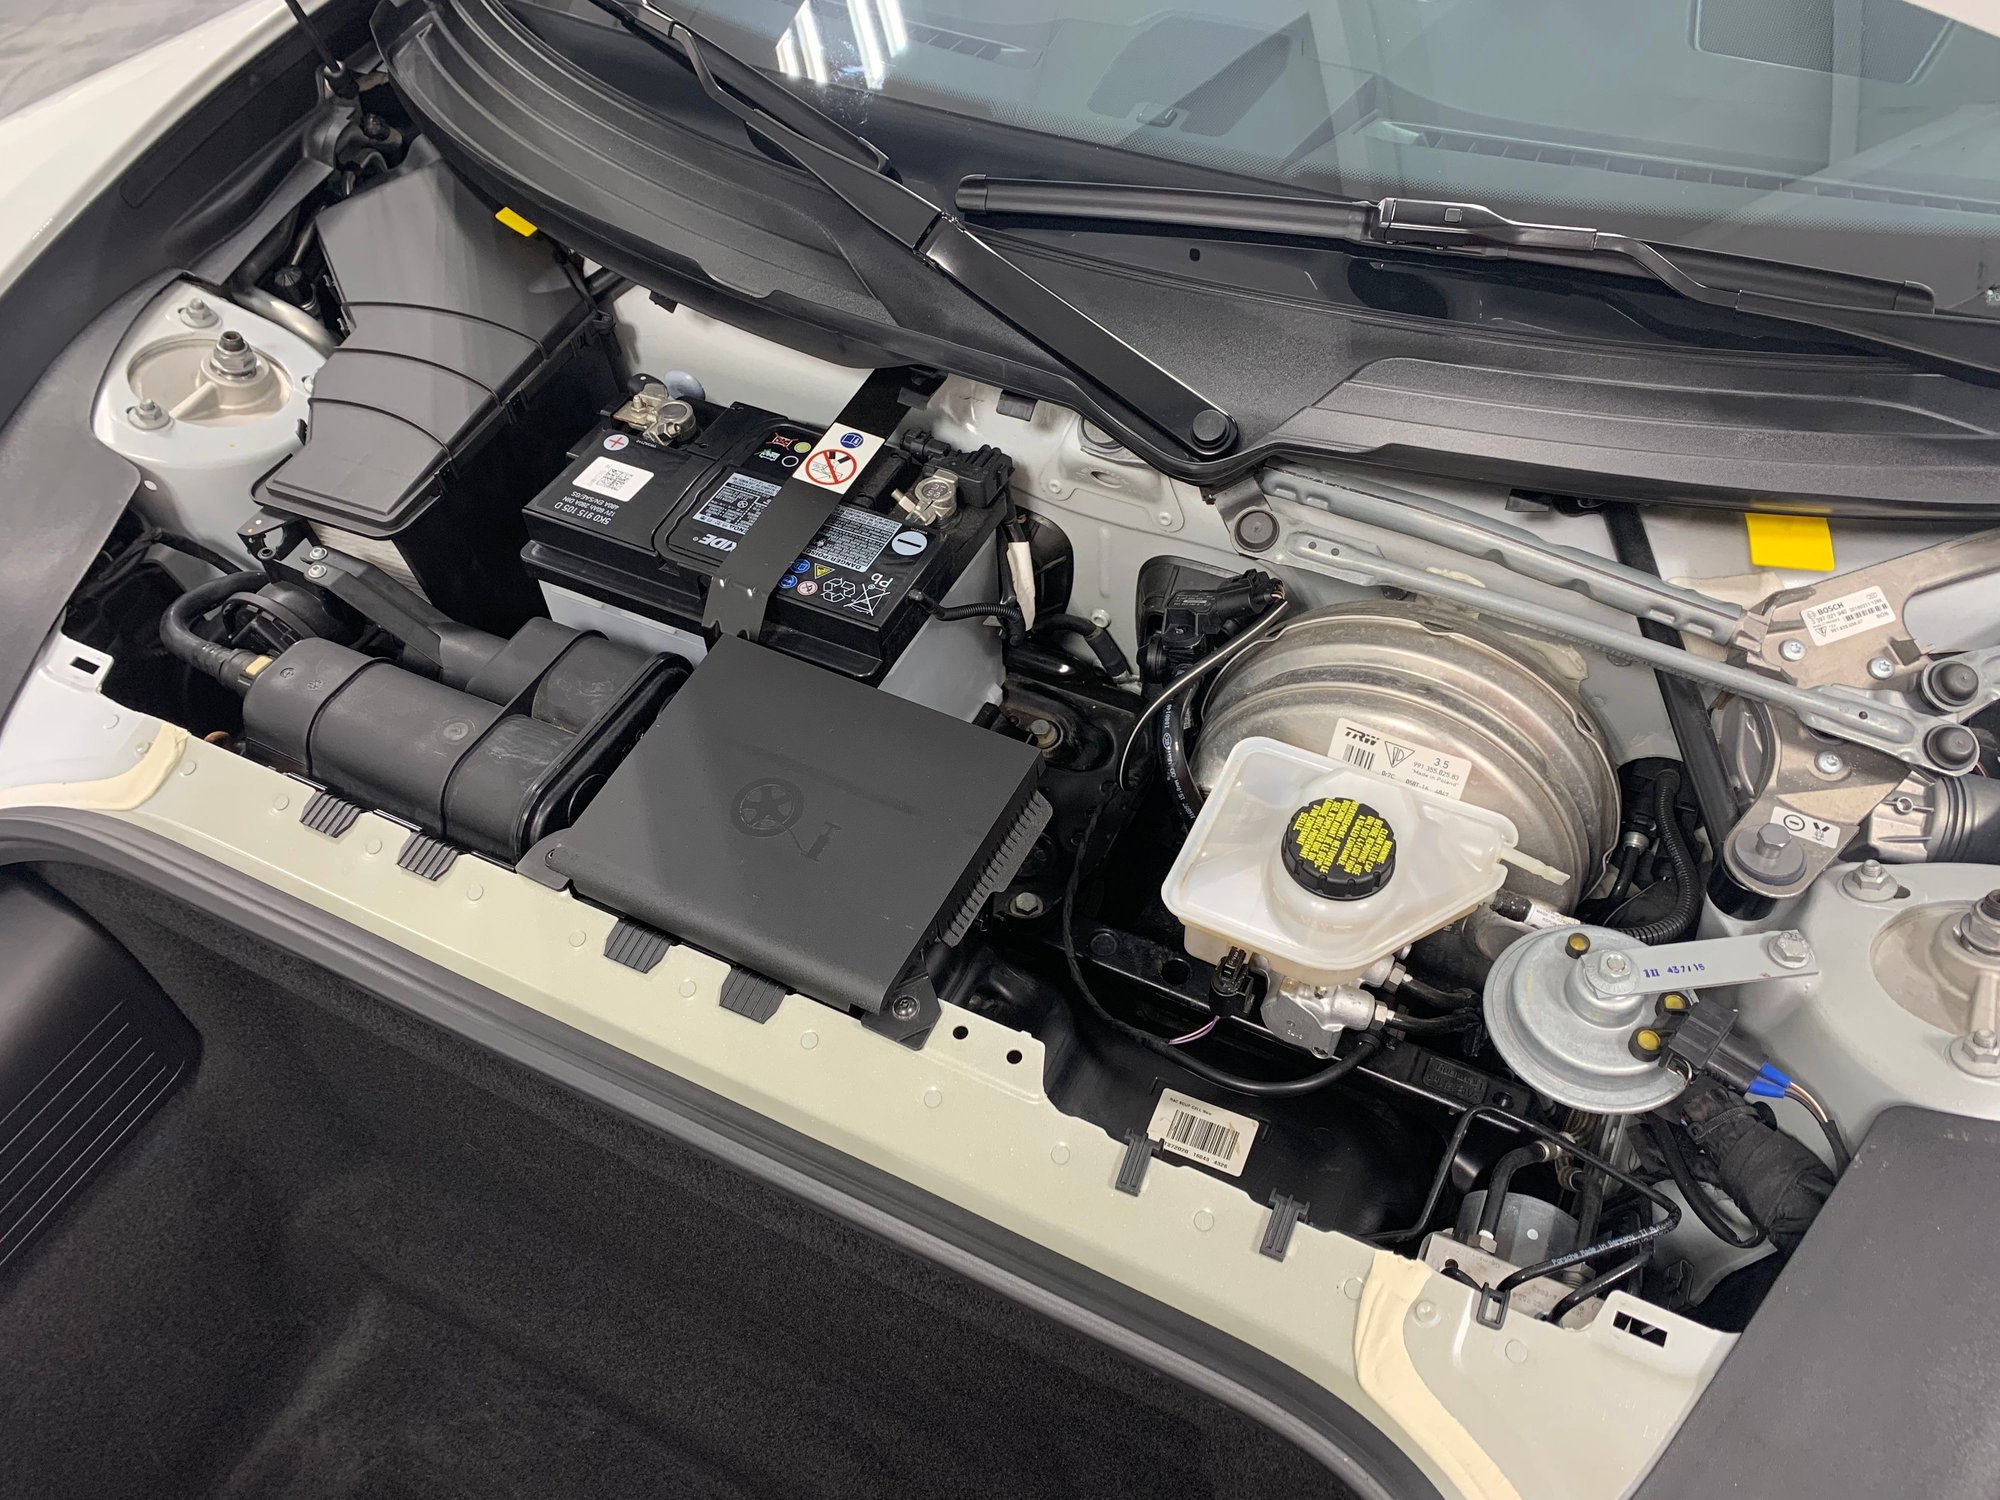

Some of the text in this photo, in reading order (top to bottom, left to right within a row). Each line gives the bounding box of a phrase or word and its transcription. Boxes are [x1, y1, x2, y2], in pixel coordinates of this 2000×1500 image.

[562, 496, 575, 504] DIN
[554, 501, 611, 525] 5K0 915 105 D
[698, 534, 737, 551] XIDE
[871, 573, 893, 587] Pb
[1817, 602, 1844, 615] BOSCH
[1345, 727, 1379, 745] TRW
[1434, 757, 1449, 769] 3.5
[1296, 815, 1315, 845] CONTENANT
[1328, 821, 1340, 837] AVANT
[1350, 819, 1364, 838] SEALED
[1362, 816, 1375, 829] ONLY
[1323, 840, 1340, 866] NETTOYER
[1364, 828, 1388, 872] CLEAN FILLER CAP
[1344, 856, 1356, 873] FROM
[1351, 864, 1362, 875] USE
[1551, 1253, 1579, 1266] Porsche
